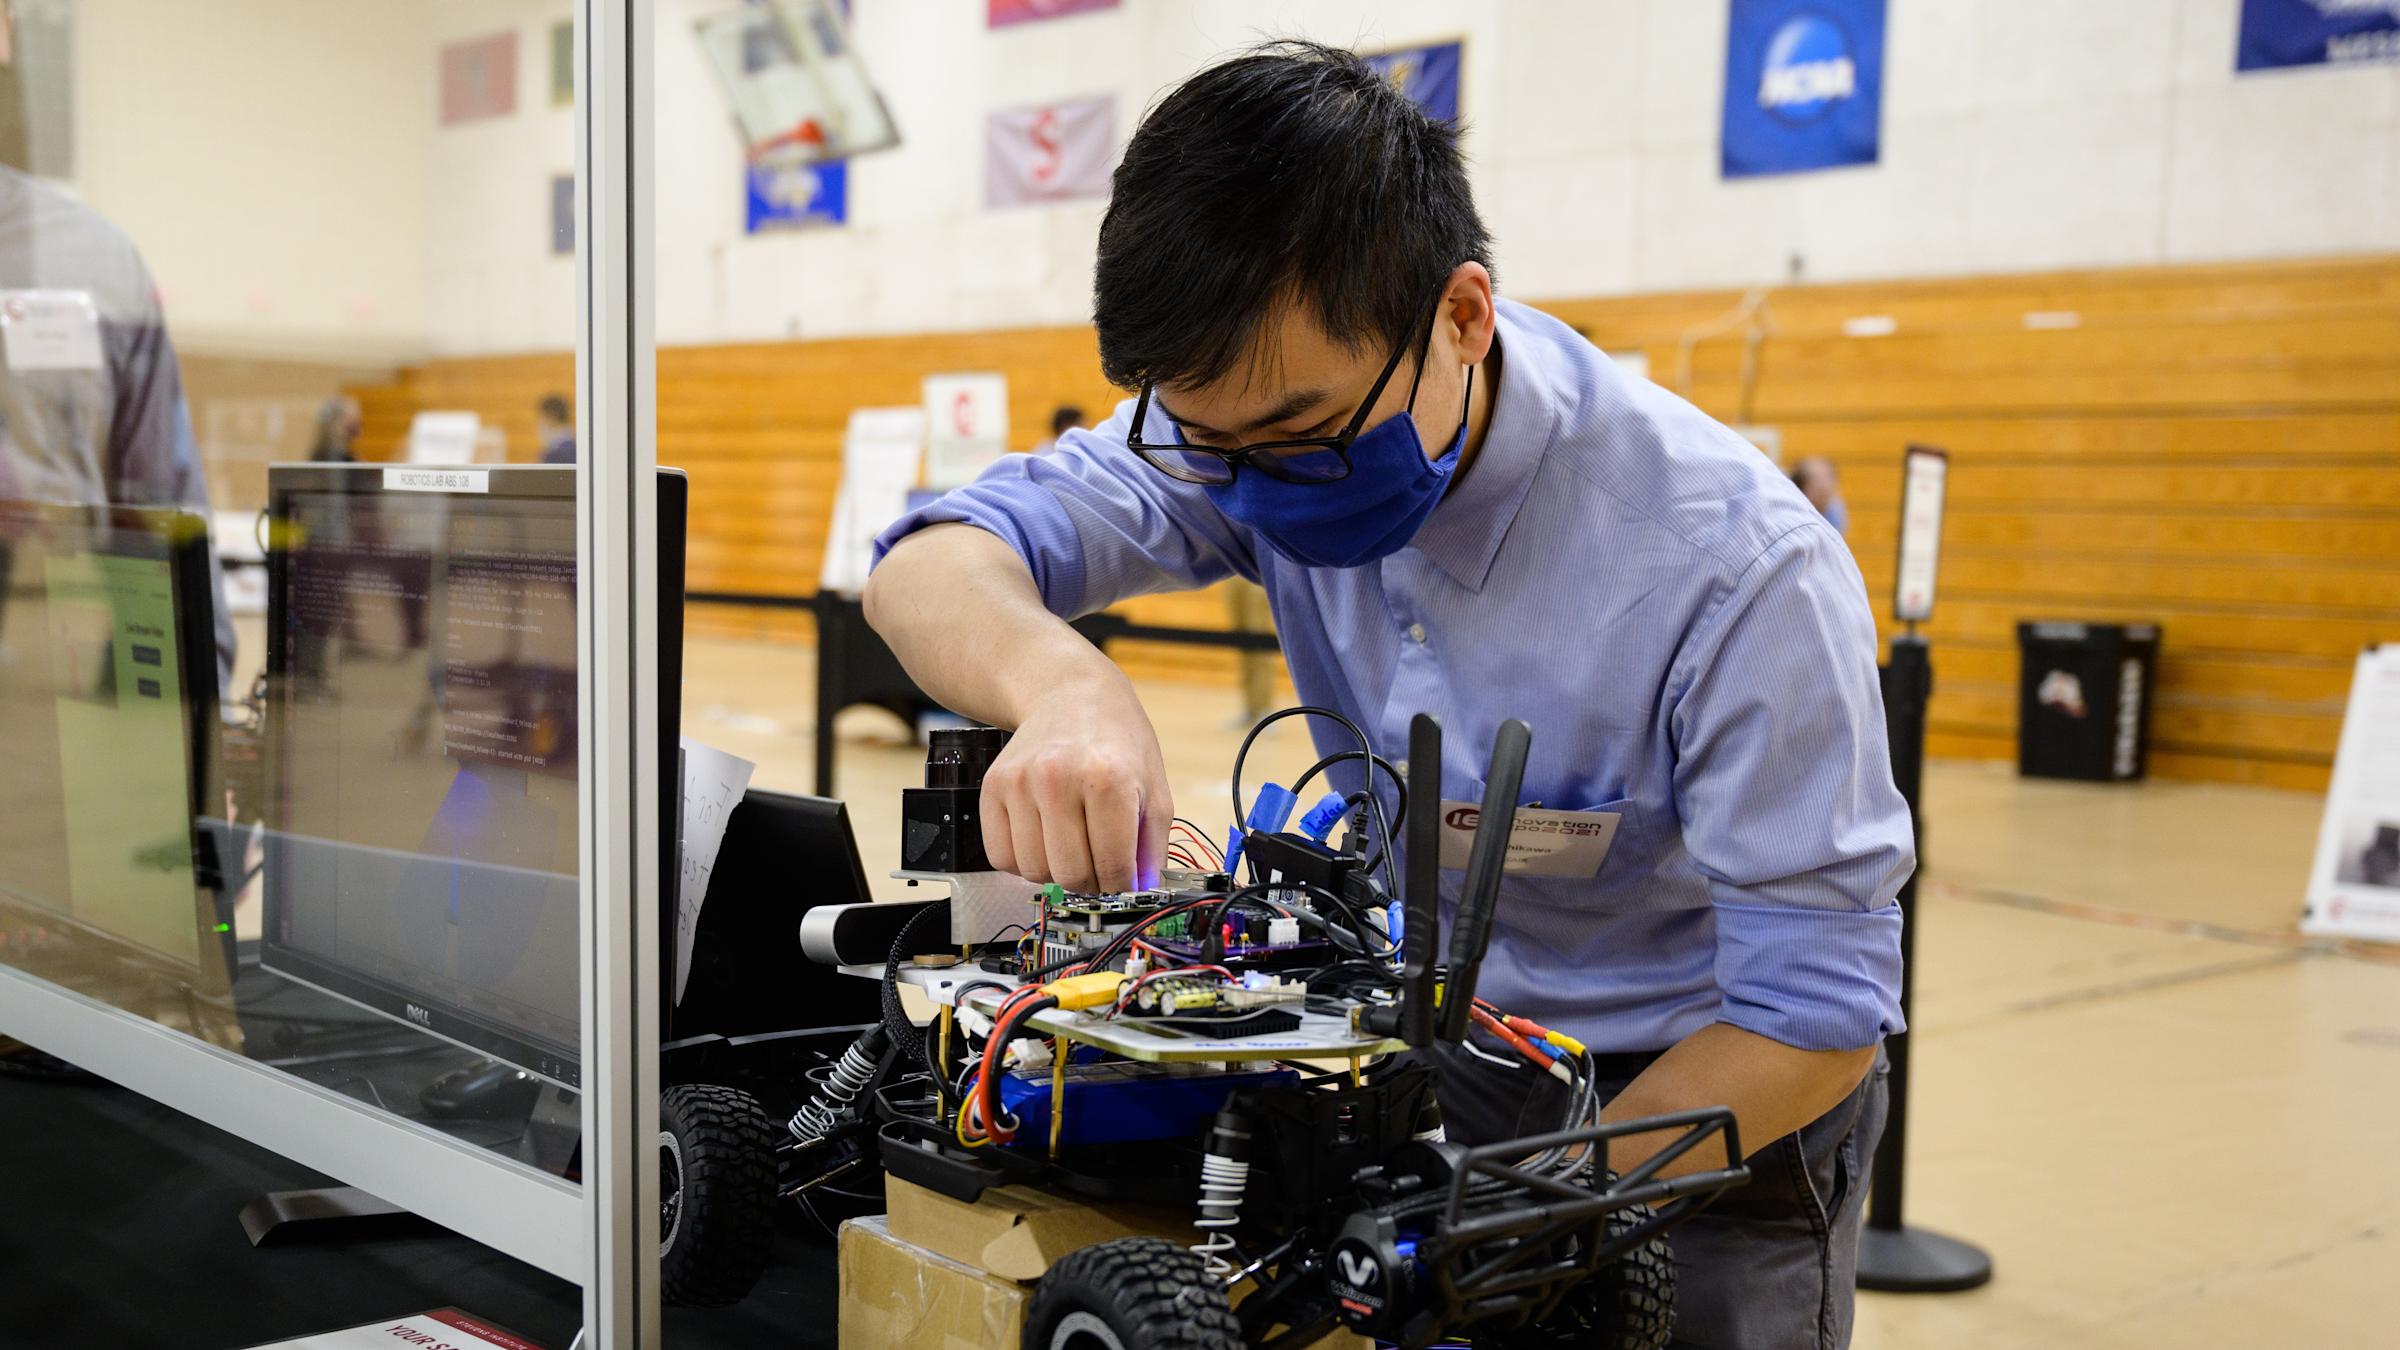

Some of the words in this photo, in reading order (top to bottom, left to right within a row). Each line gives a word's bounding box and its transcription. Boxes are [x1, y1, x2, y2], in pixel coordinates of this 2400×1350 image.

[400, 473, 431, 487] ROBOTICS
[432, 474, 444, 487] LAB
[1305, 803, 1341, 831] Lidar
[1513, 818, 1602, 830] novation
[1507, 844, 1552, 854] hikawa
[406, 1003, 431, 1026] DELL
[385, 1325, 436, 1346] YOUR
